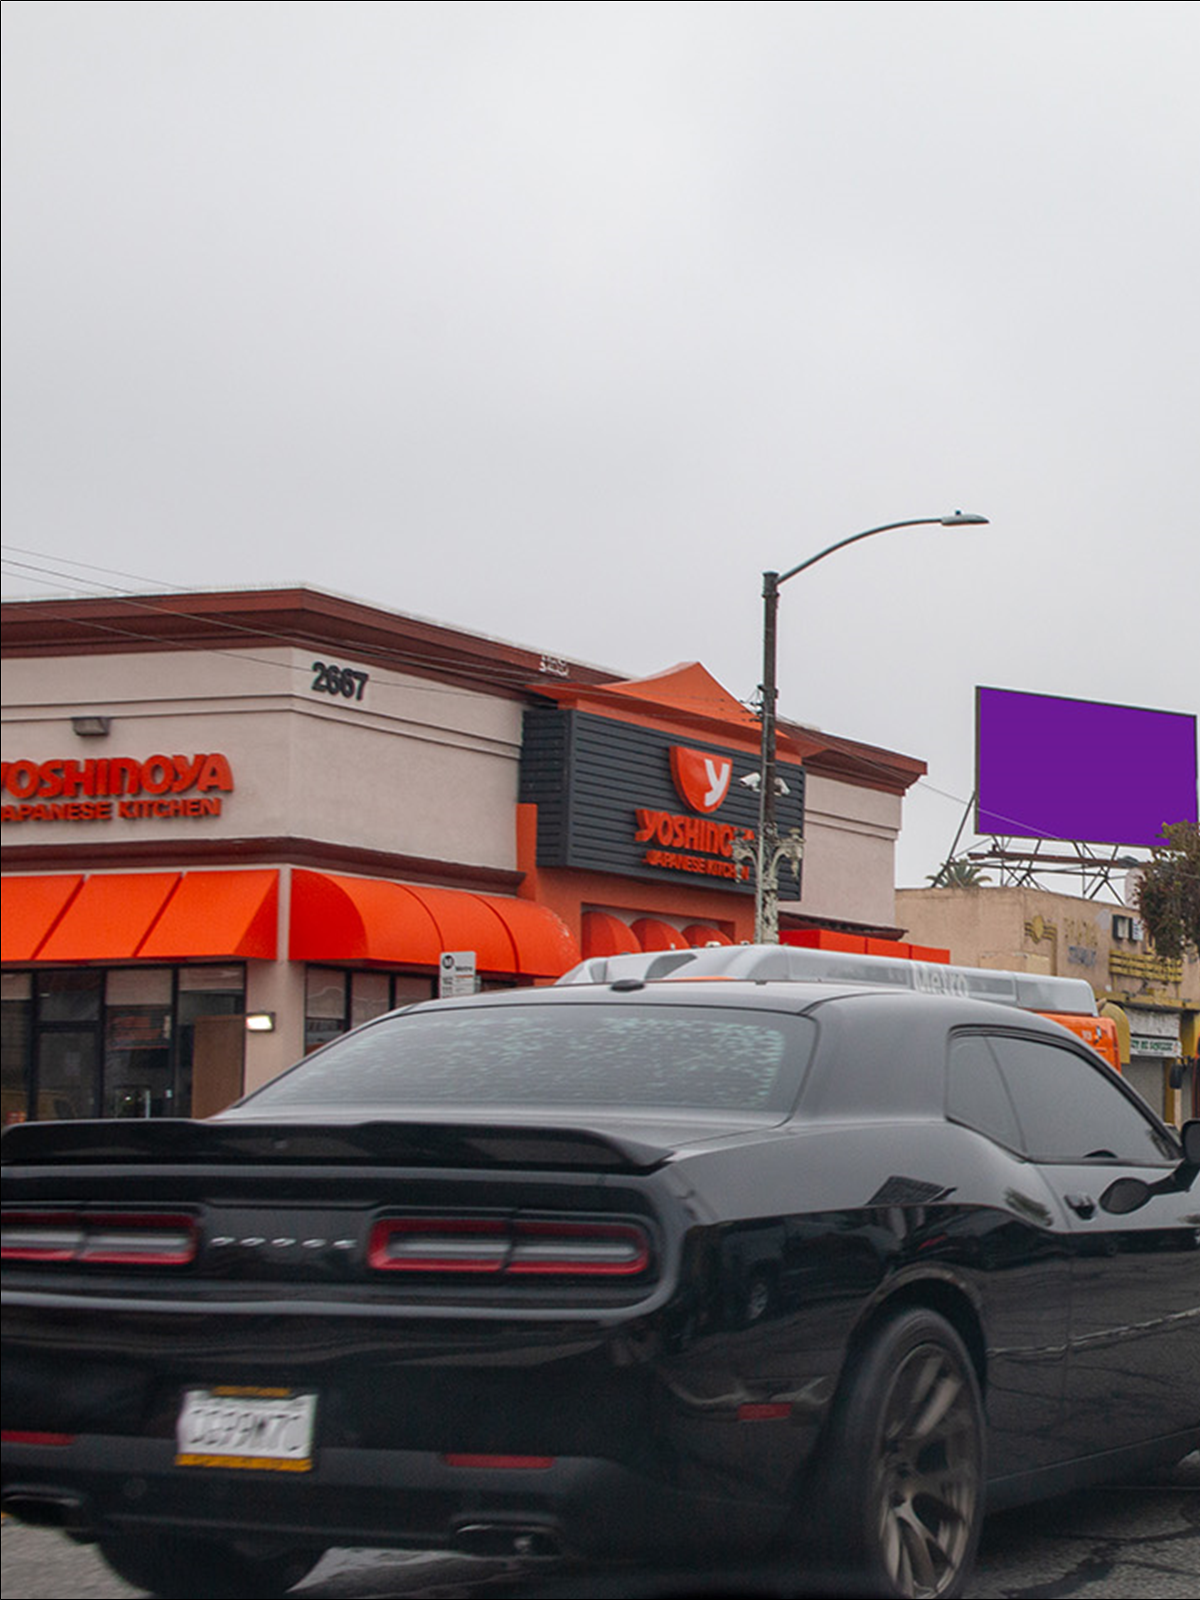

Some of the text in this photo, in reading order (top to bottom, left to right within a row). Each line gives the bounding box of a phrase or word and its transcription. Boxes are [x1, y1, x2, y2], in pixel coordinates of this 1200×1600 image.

[311, 661, 369, 701] 2667
[1, 753, 234, 799] OSHINOYA
[1, 798, 223, 822] APANESE KITCHEN
[635, 808, 755, 858] YOSHINO
[910, 961, 969, 998] Metro
